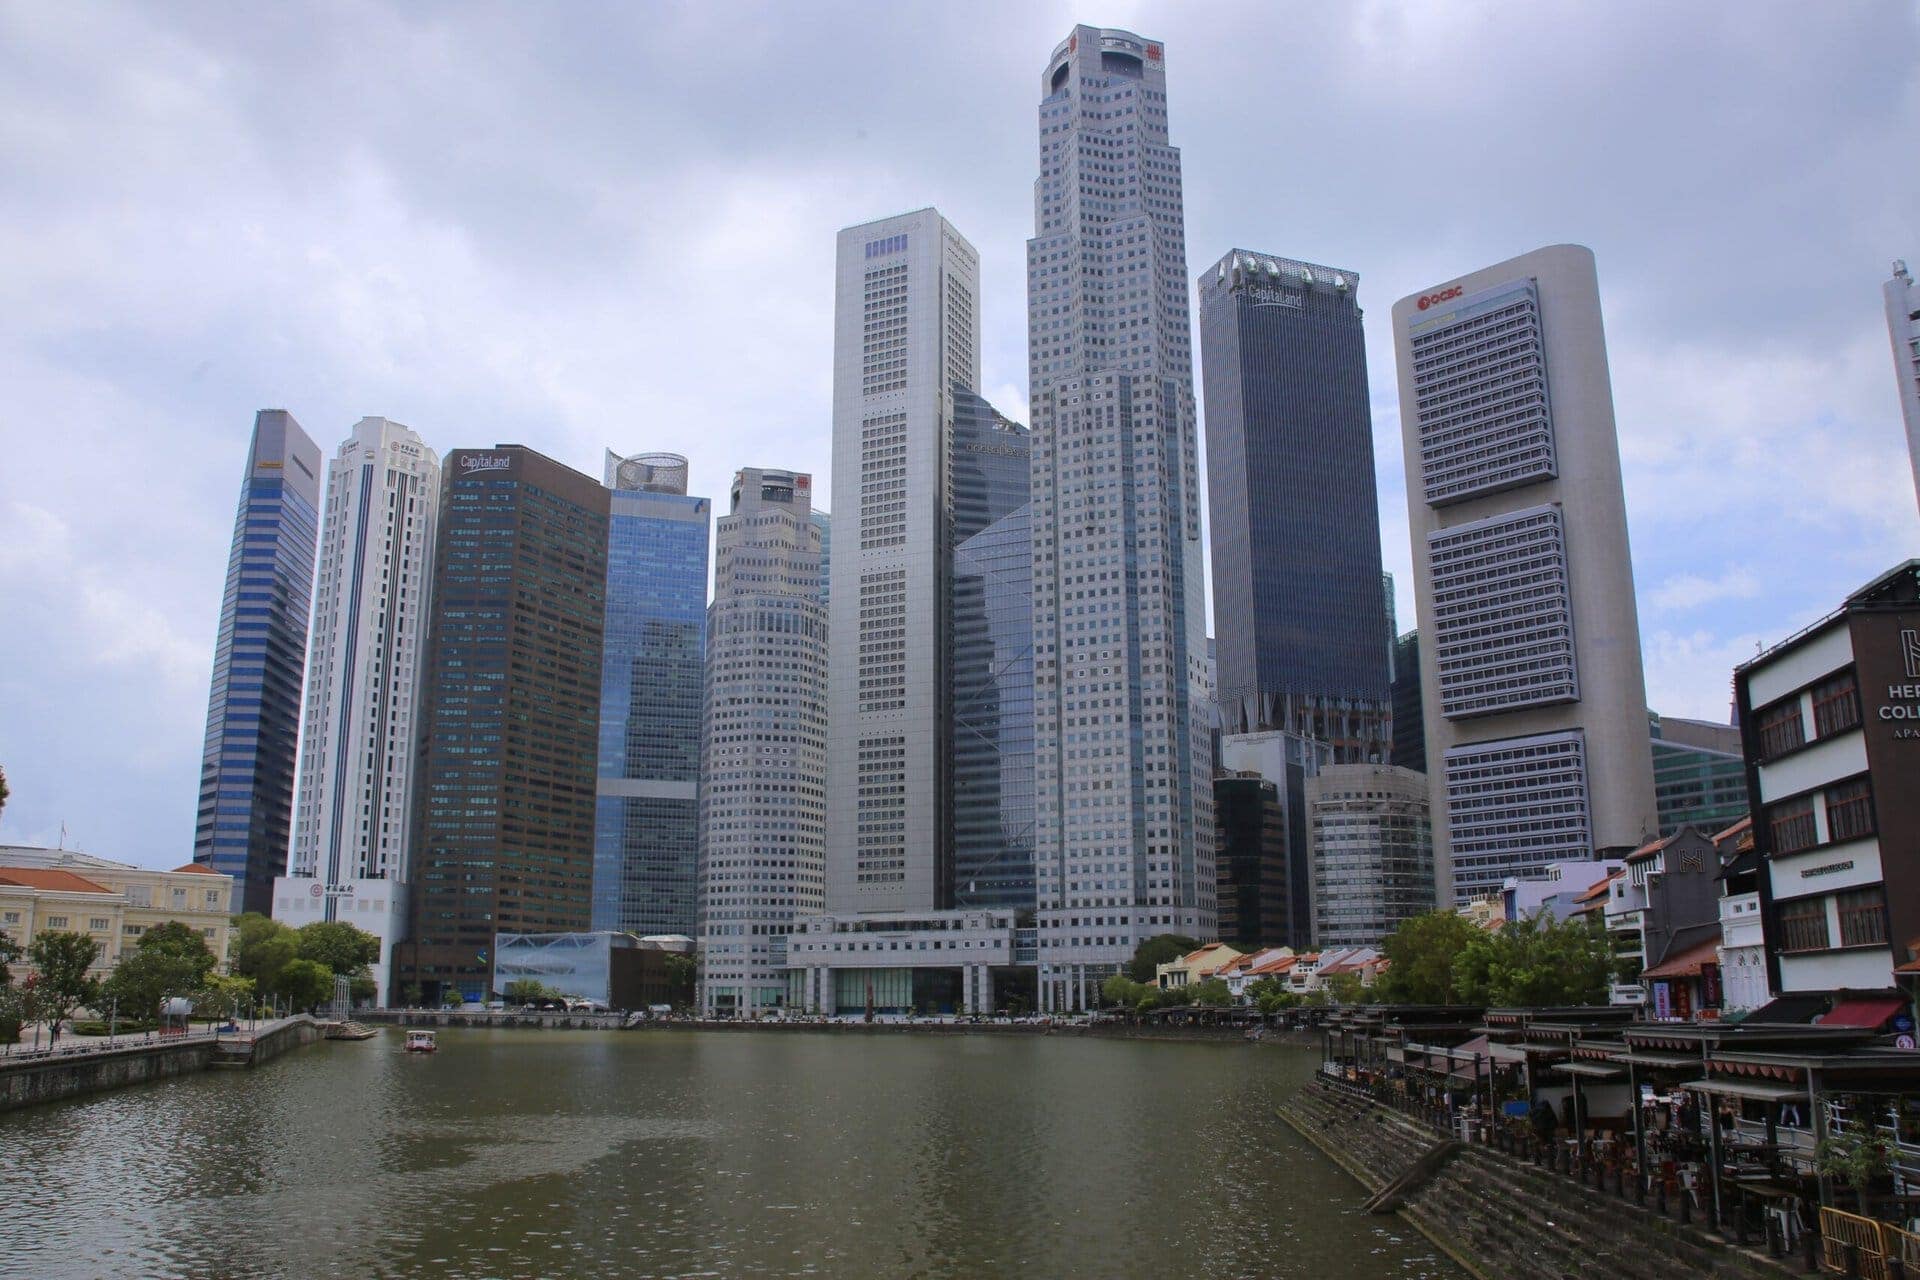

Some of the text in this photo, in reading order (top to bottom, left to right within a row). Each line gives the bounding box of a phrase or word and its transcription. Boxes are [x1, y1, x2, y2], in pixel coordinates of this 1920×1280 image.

[1248, 284, 1302, 307] CapitaLand
[1430, 285, 1463, 304] OCBC
[460, 453, 510, 470] CapitaLand
[1879, 705, 1920, 720] COL
